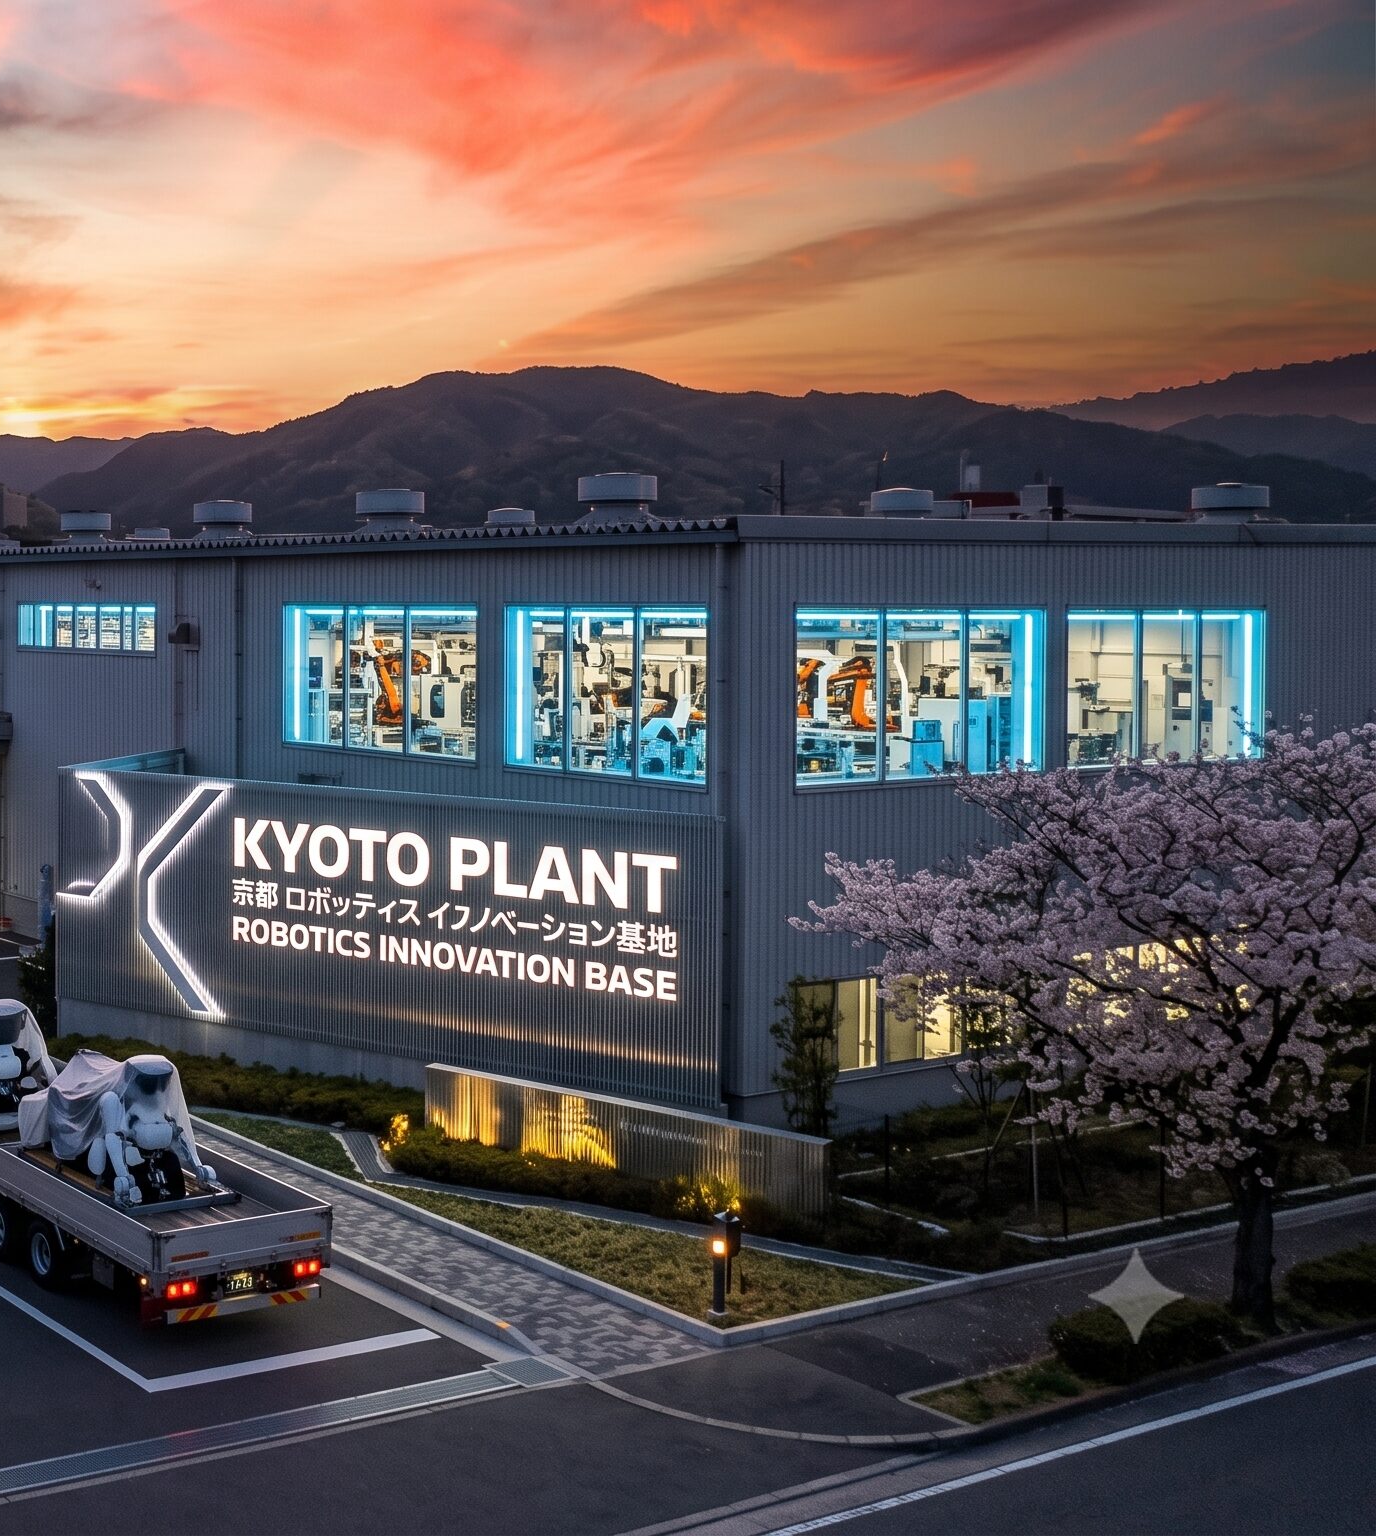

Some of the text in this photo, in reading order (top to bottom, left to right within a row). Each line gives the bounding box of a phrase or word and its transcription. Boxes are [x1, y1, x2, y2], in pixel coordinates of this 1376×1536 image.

[232, 817, 678, 914] KYOTO PLANT
[285, 886, 421, 927] ロボッティス
[232, 915, 677, 1002] ROBOTICS INNOVATION BASE
